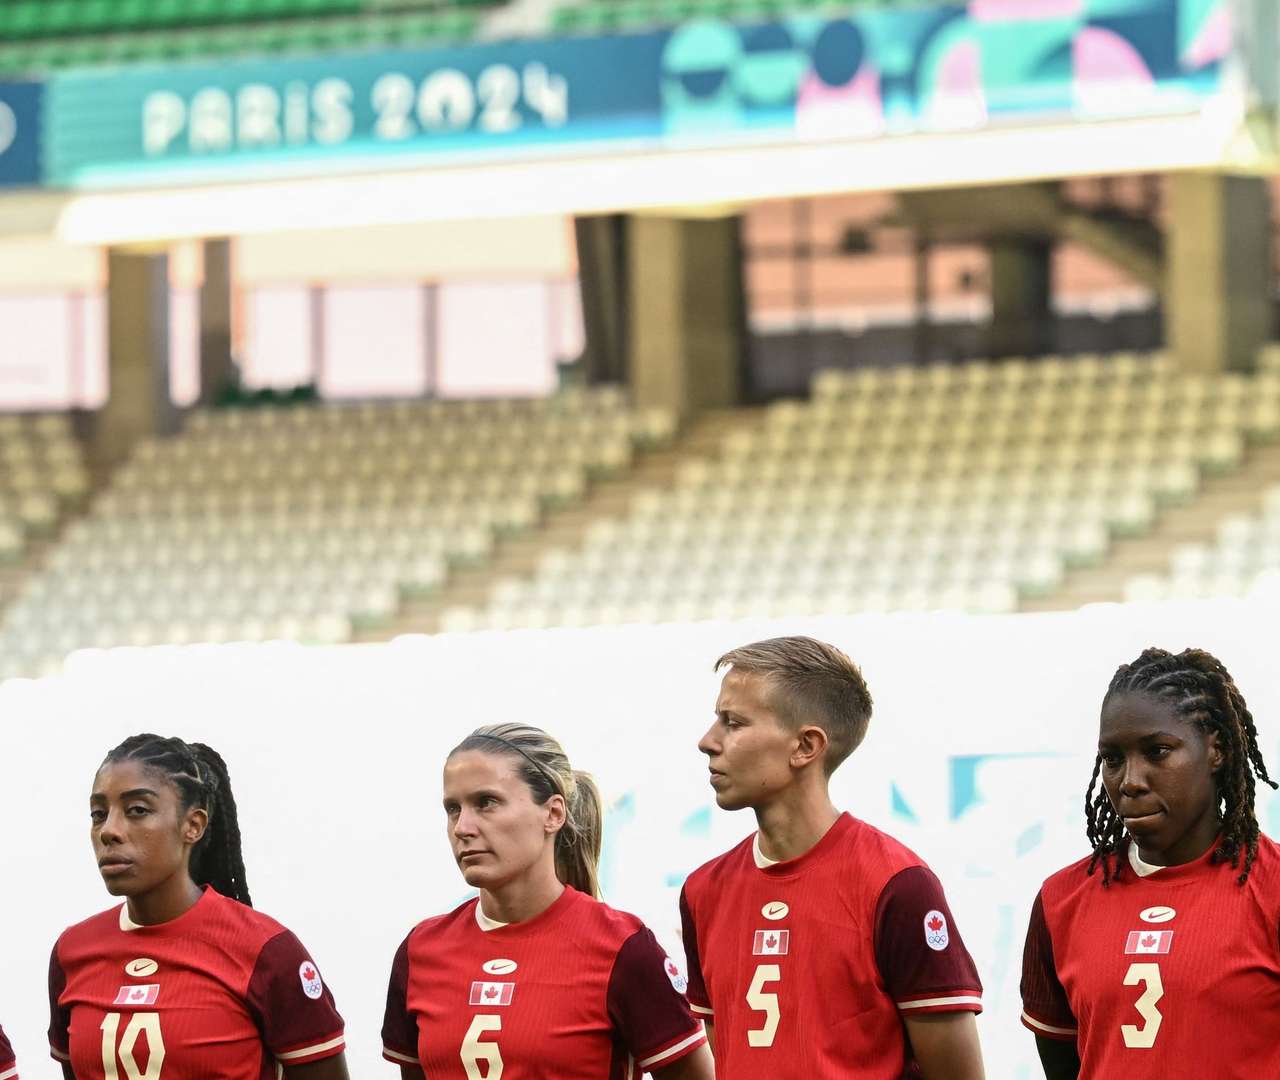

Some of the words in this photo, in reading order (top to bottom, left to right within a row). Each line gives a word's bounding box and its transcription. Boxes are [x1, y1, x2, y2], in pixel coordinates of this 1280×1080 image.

[141, 76, 356, 158] PARIS
[370, 61, 570, 142] 2024
[745, 964, 781, 1048] 5
[1120, 962, 1164, 1048] 3
